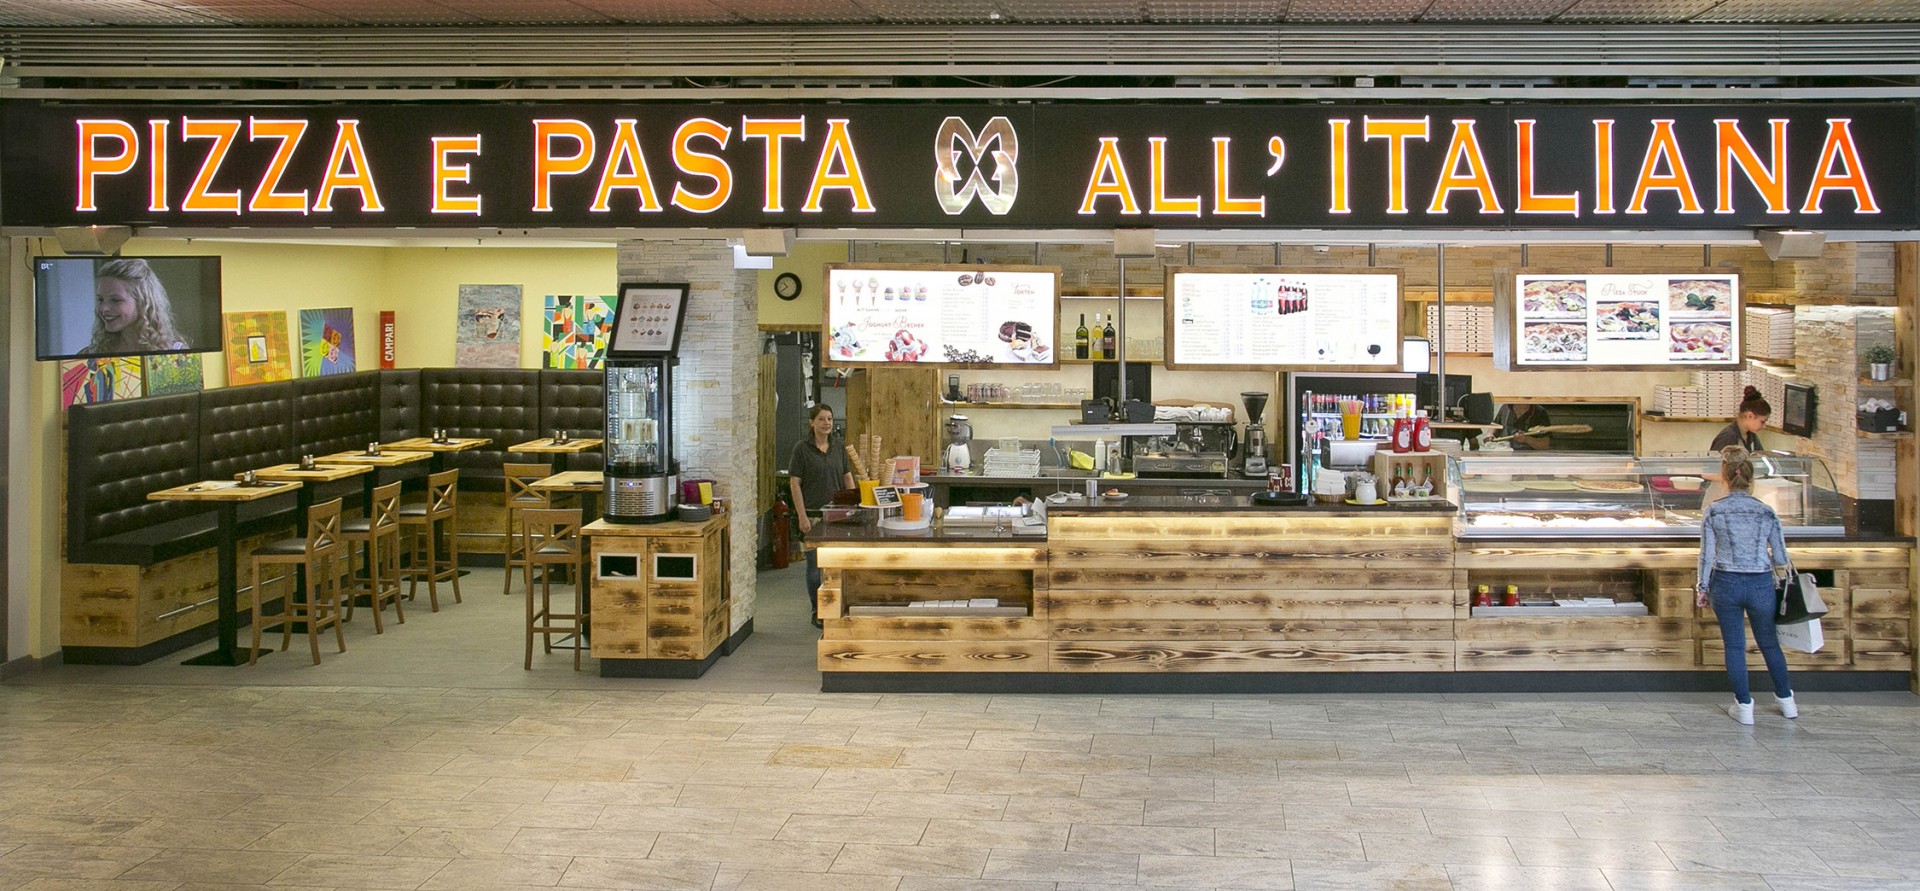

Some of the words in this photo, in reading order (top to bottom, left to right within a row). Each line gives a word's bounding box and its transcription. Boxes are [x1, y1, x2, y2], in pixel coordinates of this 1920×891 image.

[76, 116, 385, 215] PIZZA
[431, 134, 482, 216] E
[532, 115, 876, 214] PASTA
[1328, 115, 1881, 218] ITALIANA
[384, 323, 394, 361] CAMPARI
